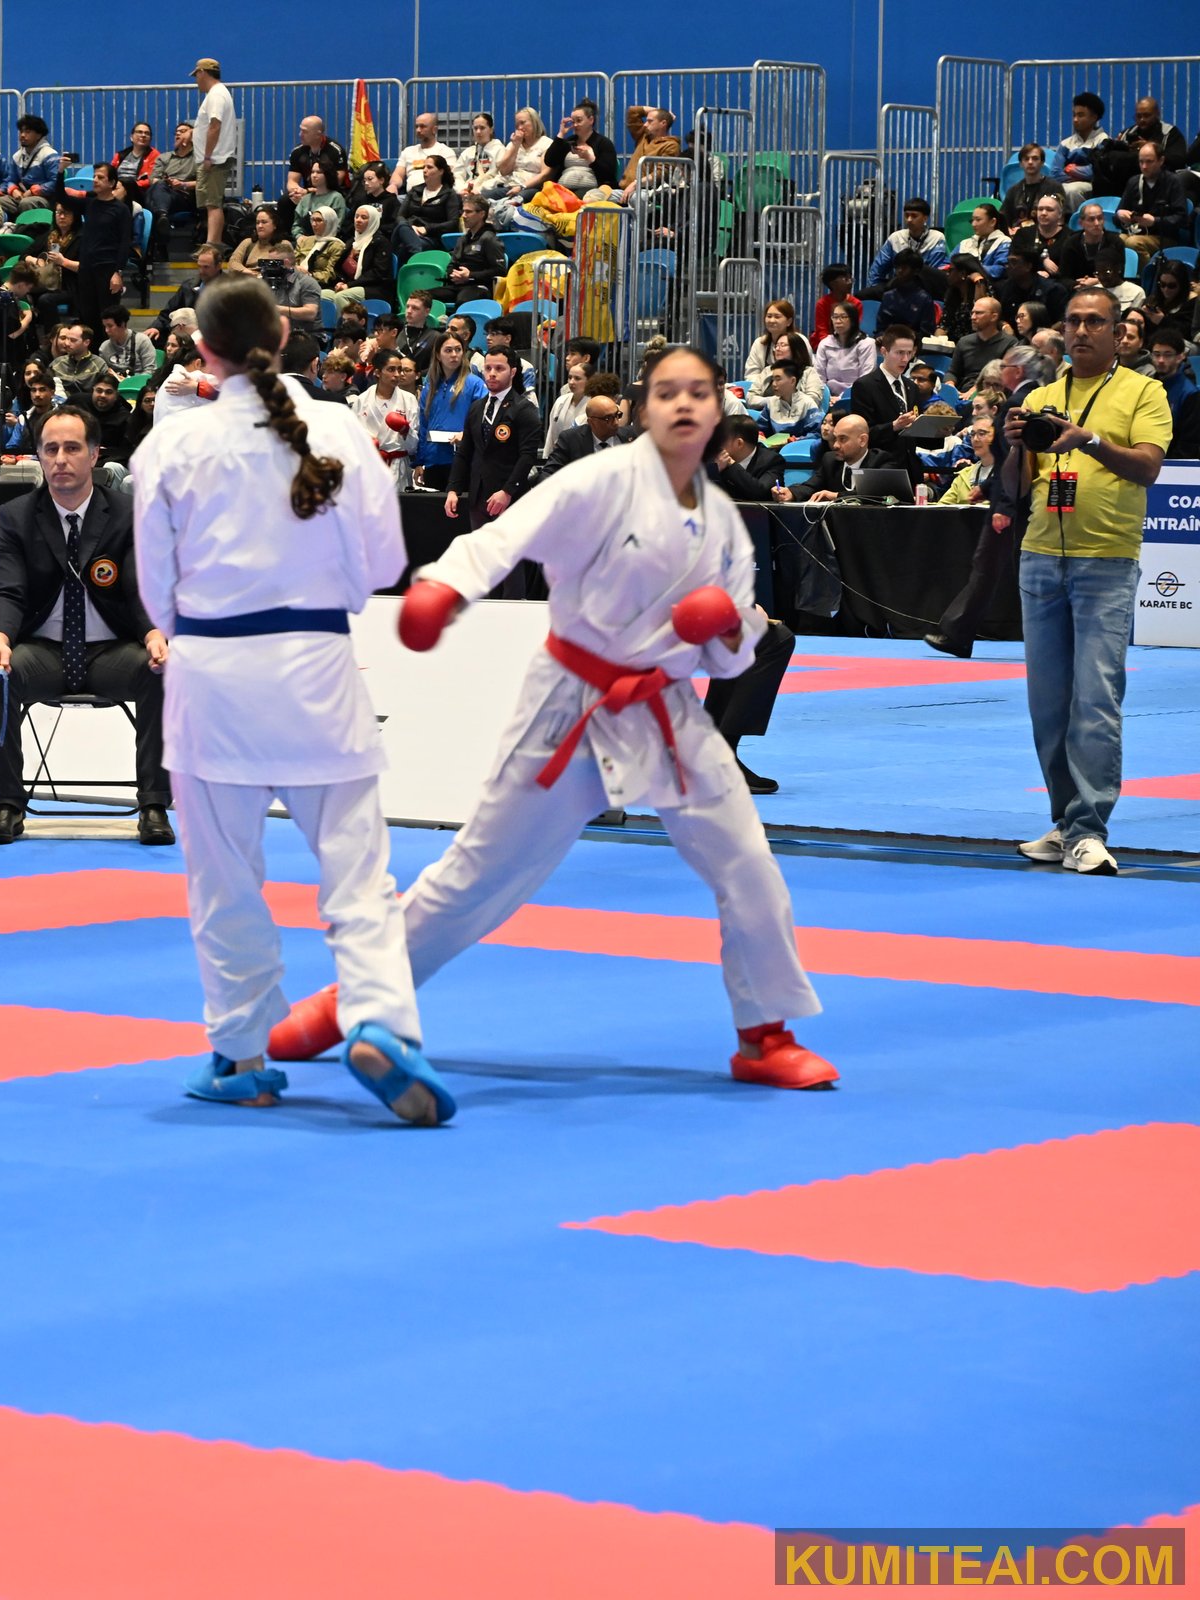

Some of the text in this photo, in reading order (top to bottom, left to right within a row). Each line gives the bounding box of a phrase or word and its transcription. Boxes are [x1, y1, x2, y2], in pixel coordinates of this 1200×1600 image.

[1168, 495, 1200, 509] COA
[1139, 600, 1192, 610] KARATE BC
